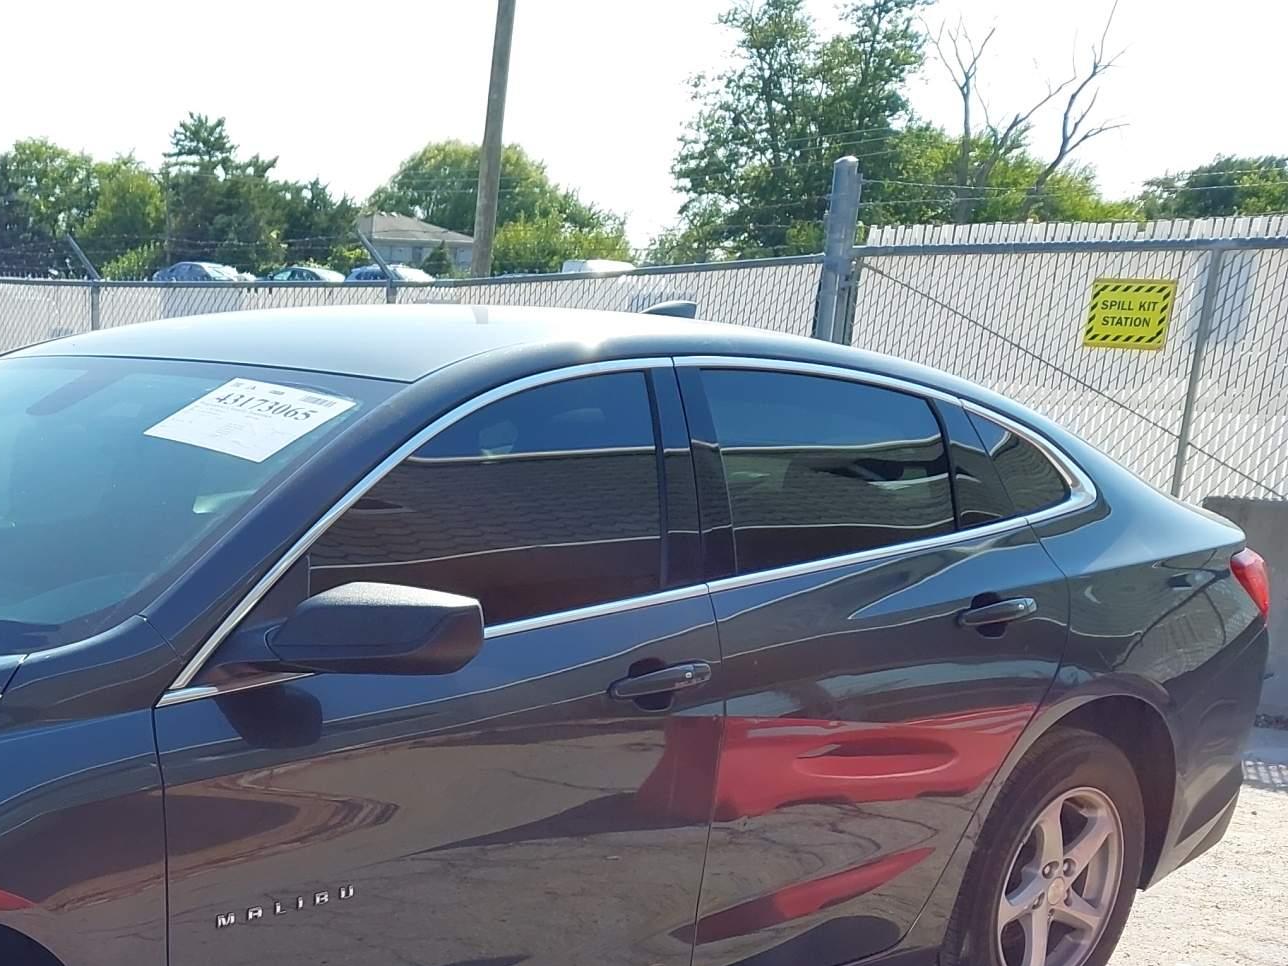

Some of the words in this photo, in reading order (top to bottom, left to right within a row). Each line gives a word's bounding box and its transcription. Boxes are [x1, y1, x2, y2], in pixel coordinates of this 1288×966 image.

[1100, 300, 1134, 311] SPILL
[1138, 300, 1160, 312] KIT
[1101, 315, 1151, 328] STATION
[215, 392, 319, 421] 43173065
[216, 884, 354, 929] MALIBU
